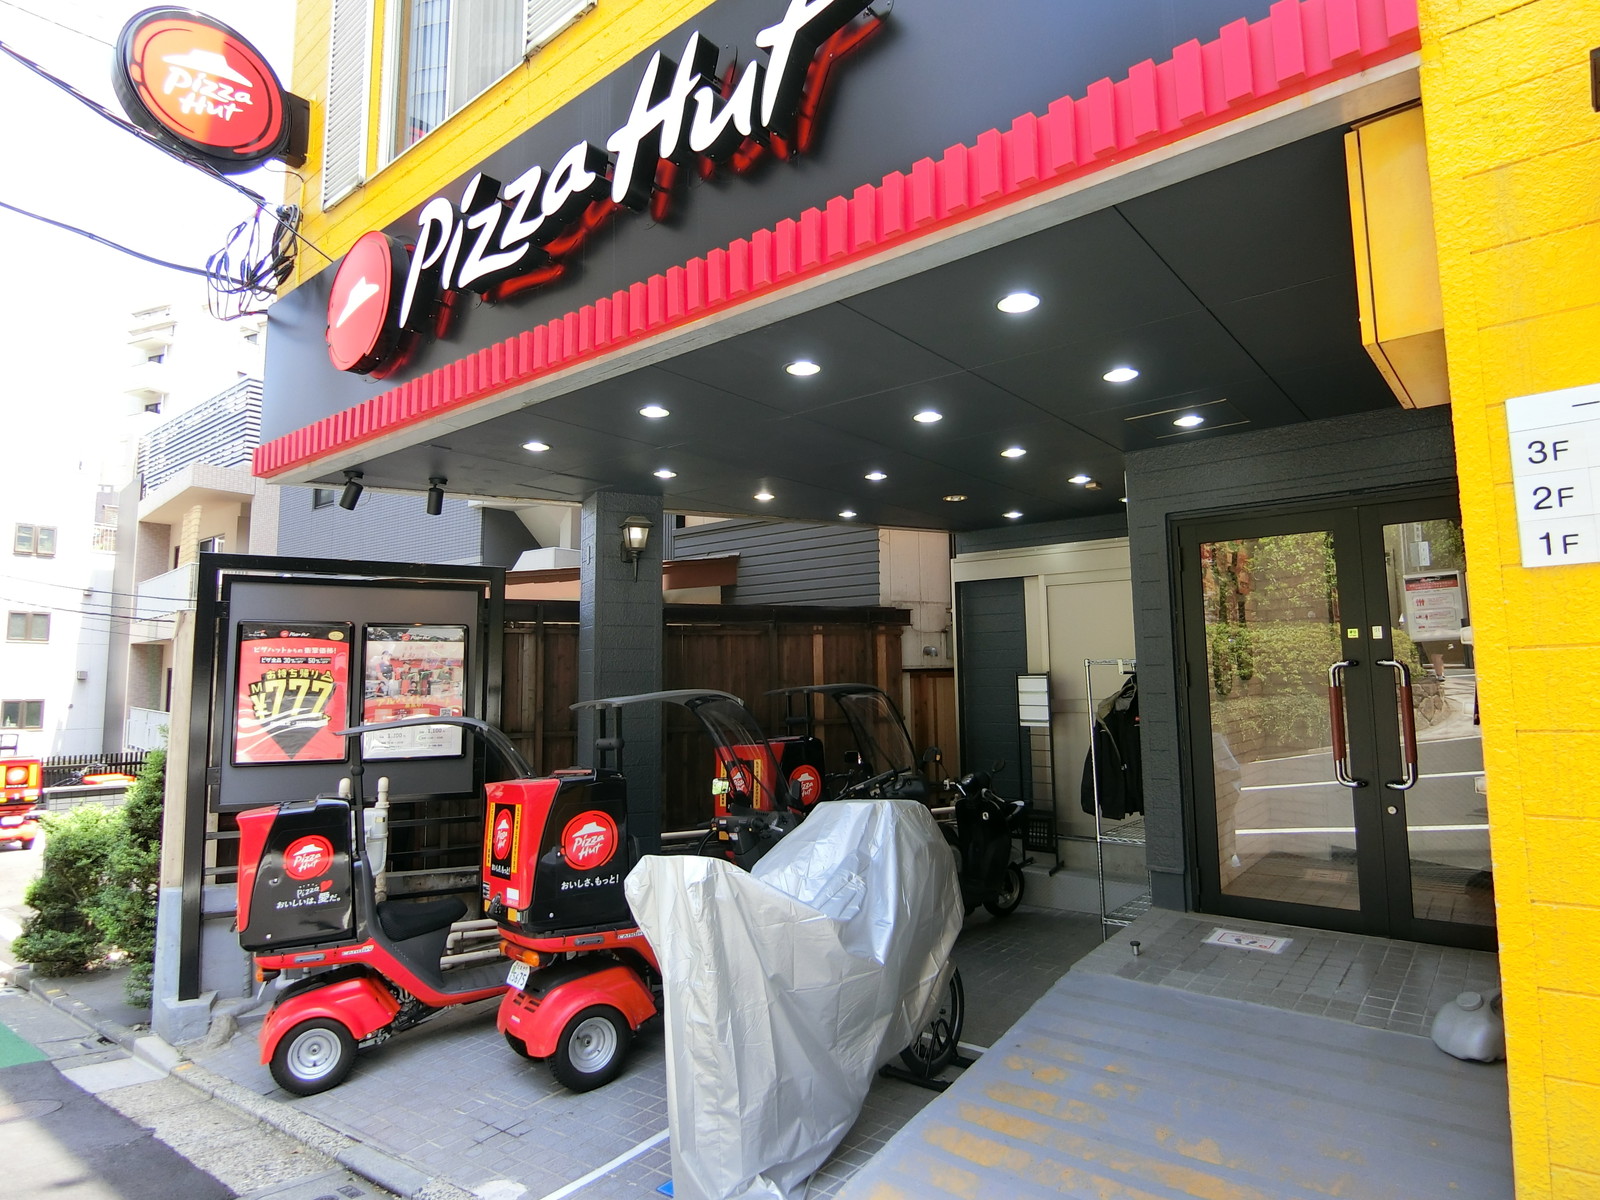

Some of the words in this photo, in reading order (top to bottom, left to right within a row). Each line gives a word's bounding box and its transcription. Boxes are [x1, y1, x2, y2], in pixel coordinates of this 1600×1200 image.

[163, 65, 253, 105] Pizza
[179, 93, 243, 121] Hut
[399, 140, 596, 328] Pizza
[606, 0, 835, 203] Hut
[1527, 439, 1569, 464] 3F
[1532, 486, 1574, 510] 2F
[1538, 531, 1579, 556] 1F
[572, 834, 605, 853] Pizza
[578, 843, 603, 860] Hut
[293, 854, 321, 868] Pizza
[298, 859, 320, 872] Hut
[297, 885, 320, 899] Pizza
